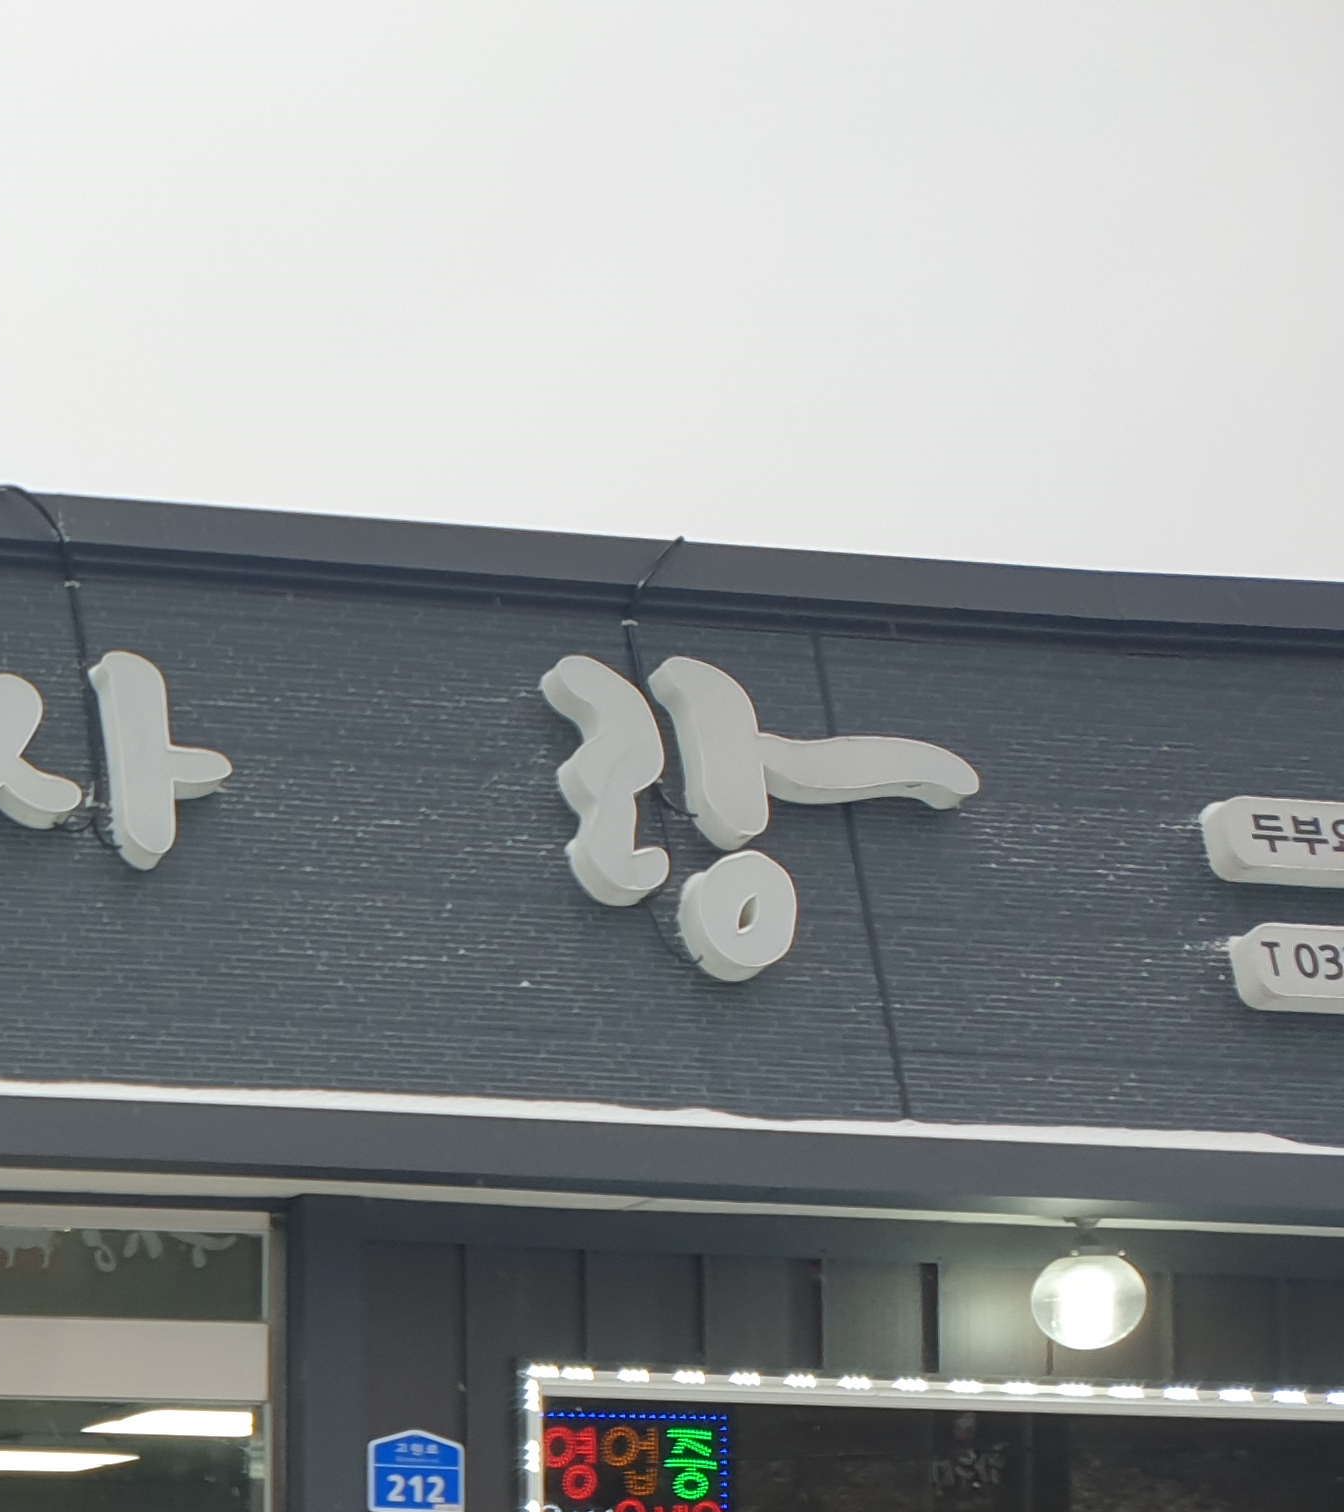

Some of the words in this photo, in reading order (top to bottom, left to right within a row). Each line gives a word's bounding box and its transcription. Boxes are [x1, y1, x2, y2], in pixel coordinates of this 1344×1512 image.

[1261, 941, 1280, 976] T
[1293, 943, 1344, 980] 03
[545, 1425, 717, 1500] 영업중
[386, 1473, 445, 1503] 212
